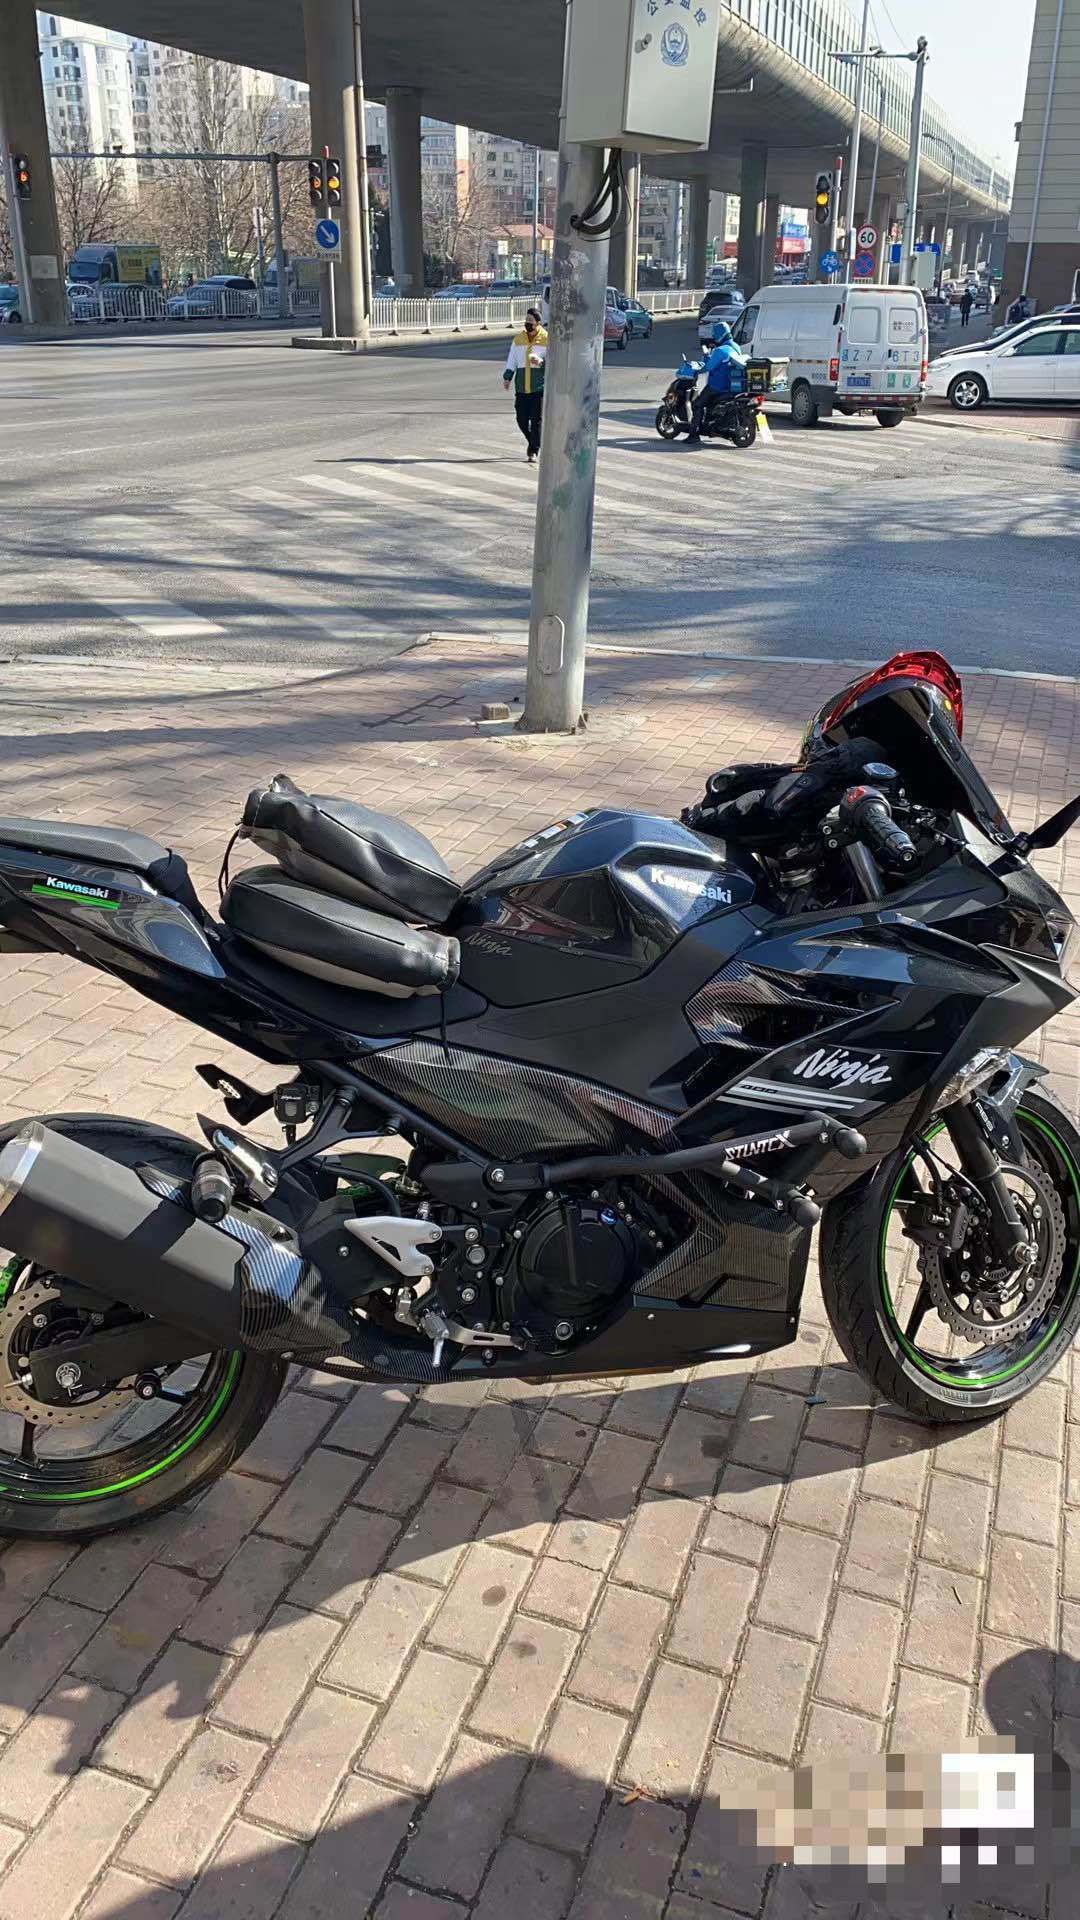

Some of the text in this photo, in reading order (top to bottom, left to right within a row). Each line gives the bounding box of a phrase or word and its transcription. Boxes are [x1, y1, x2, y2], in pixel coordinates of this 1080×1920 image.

[860, 232, 874, 243] 60
[46, 876, 109, 898] Kawasaki
[650, 866, 732, 904] Kawasaki
[464, 931, 513, 956] Ninja
[793, 1048, 892, 1090] Ninja
